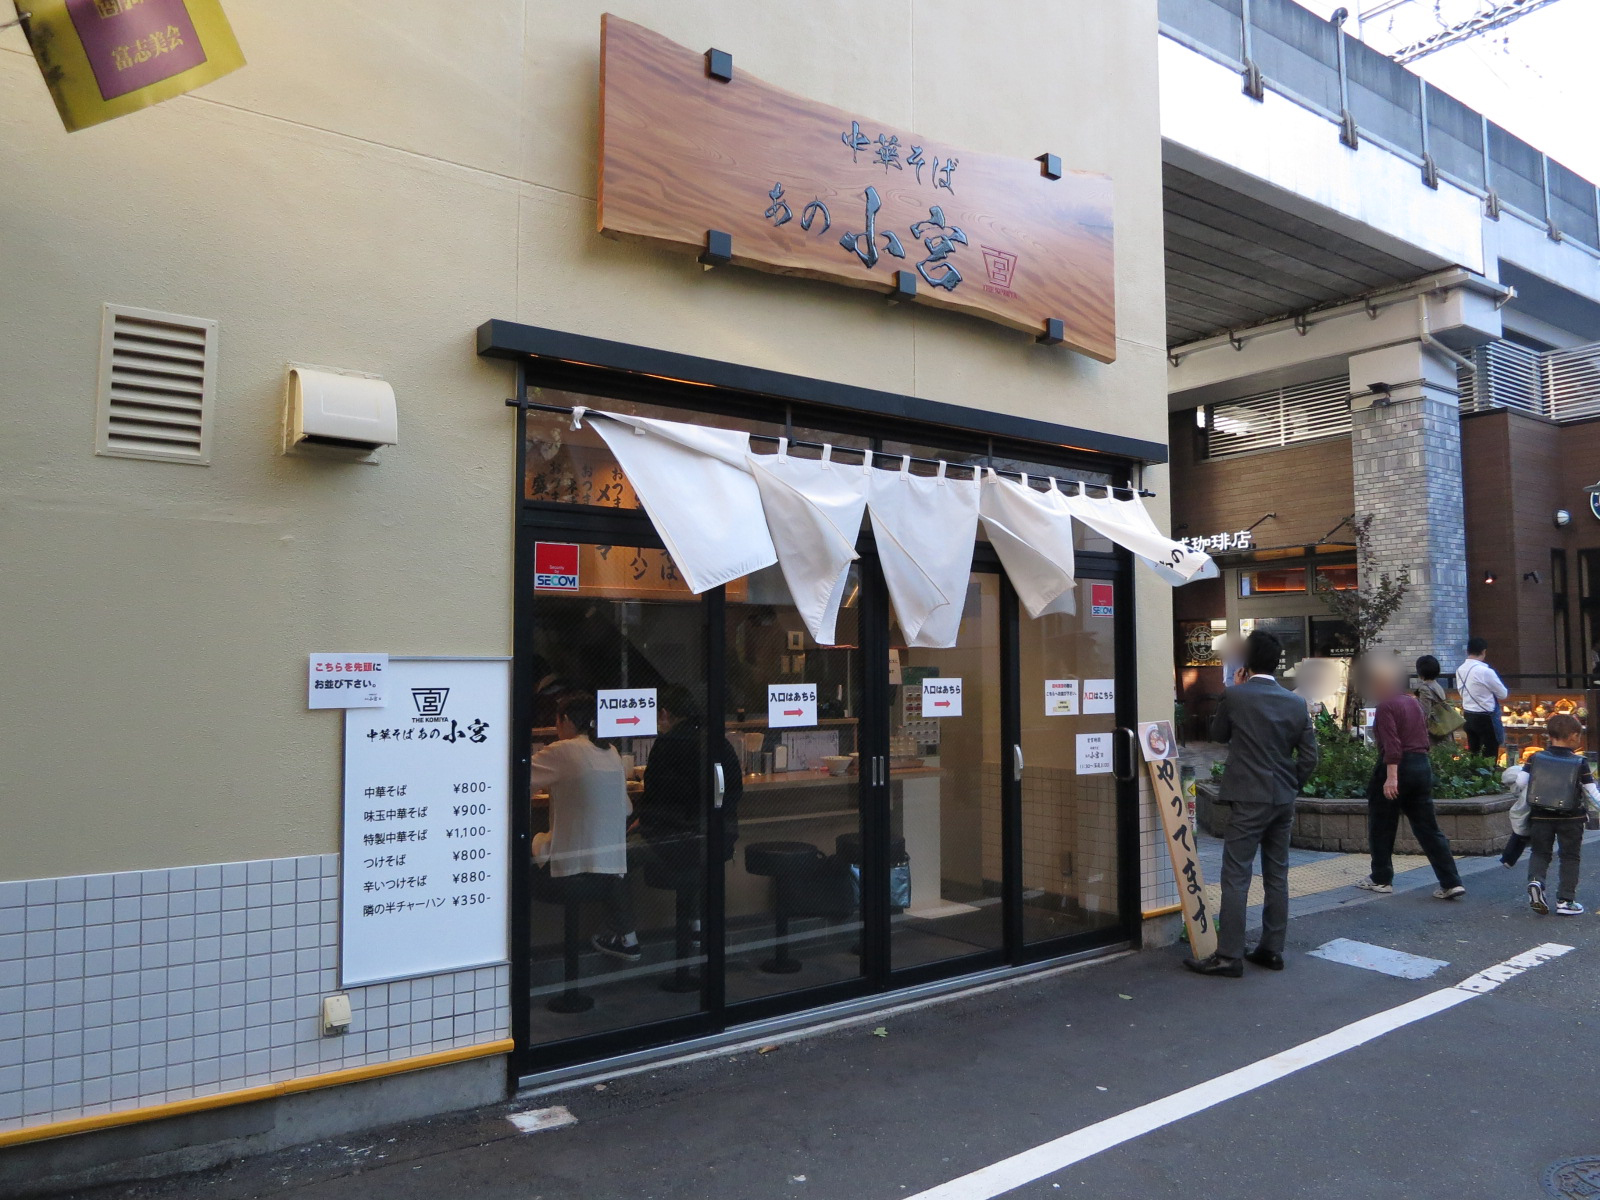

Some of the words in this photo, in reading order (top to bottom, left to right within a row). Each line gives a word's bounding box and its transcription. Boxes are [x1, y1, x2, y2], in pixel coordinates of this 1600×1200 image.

[842, 121, 959, 195] 中華そば
[764, 182, 968, 291] あの小宮
[537, 575, 576, 586] SECOM
[1093, 606, 1112, 614] SECOM
[316, 662, 382, 672] こちらを先頭に
[314, 679, 377, 689] お並び下さい。
[924, 685, 961, 695] 入口はあちら
[599, 697, 656, 710] 入口はあちら
[770, 691, 816, 703] 入口はあちら
[1083, 692, 1114, 700] 入口はこちら
[364, 784, 408, 799] 中華そば
[453, 781, 492, 793] ¥800-
[363, 806, 428, 822] 味玉中華そば
[453, 803, 491, 816] ¥900-
[363, 829, 428, 846] 特製中華そば
[446, 826, 491, 838] ¥1,100-
[1157, 759, 1207, 934] やってます
[363, 854, 407, 868] つけそば
[453, 848, 491, 861] ¥800-
[363, 875, 428, 893] 辛いつけそば
[452, 870, 491, 884] ¥880-
[363, 897, 446, 917] 隣の半チャーハン
[452, 892, 491, 906] ¥350-
